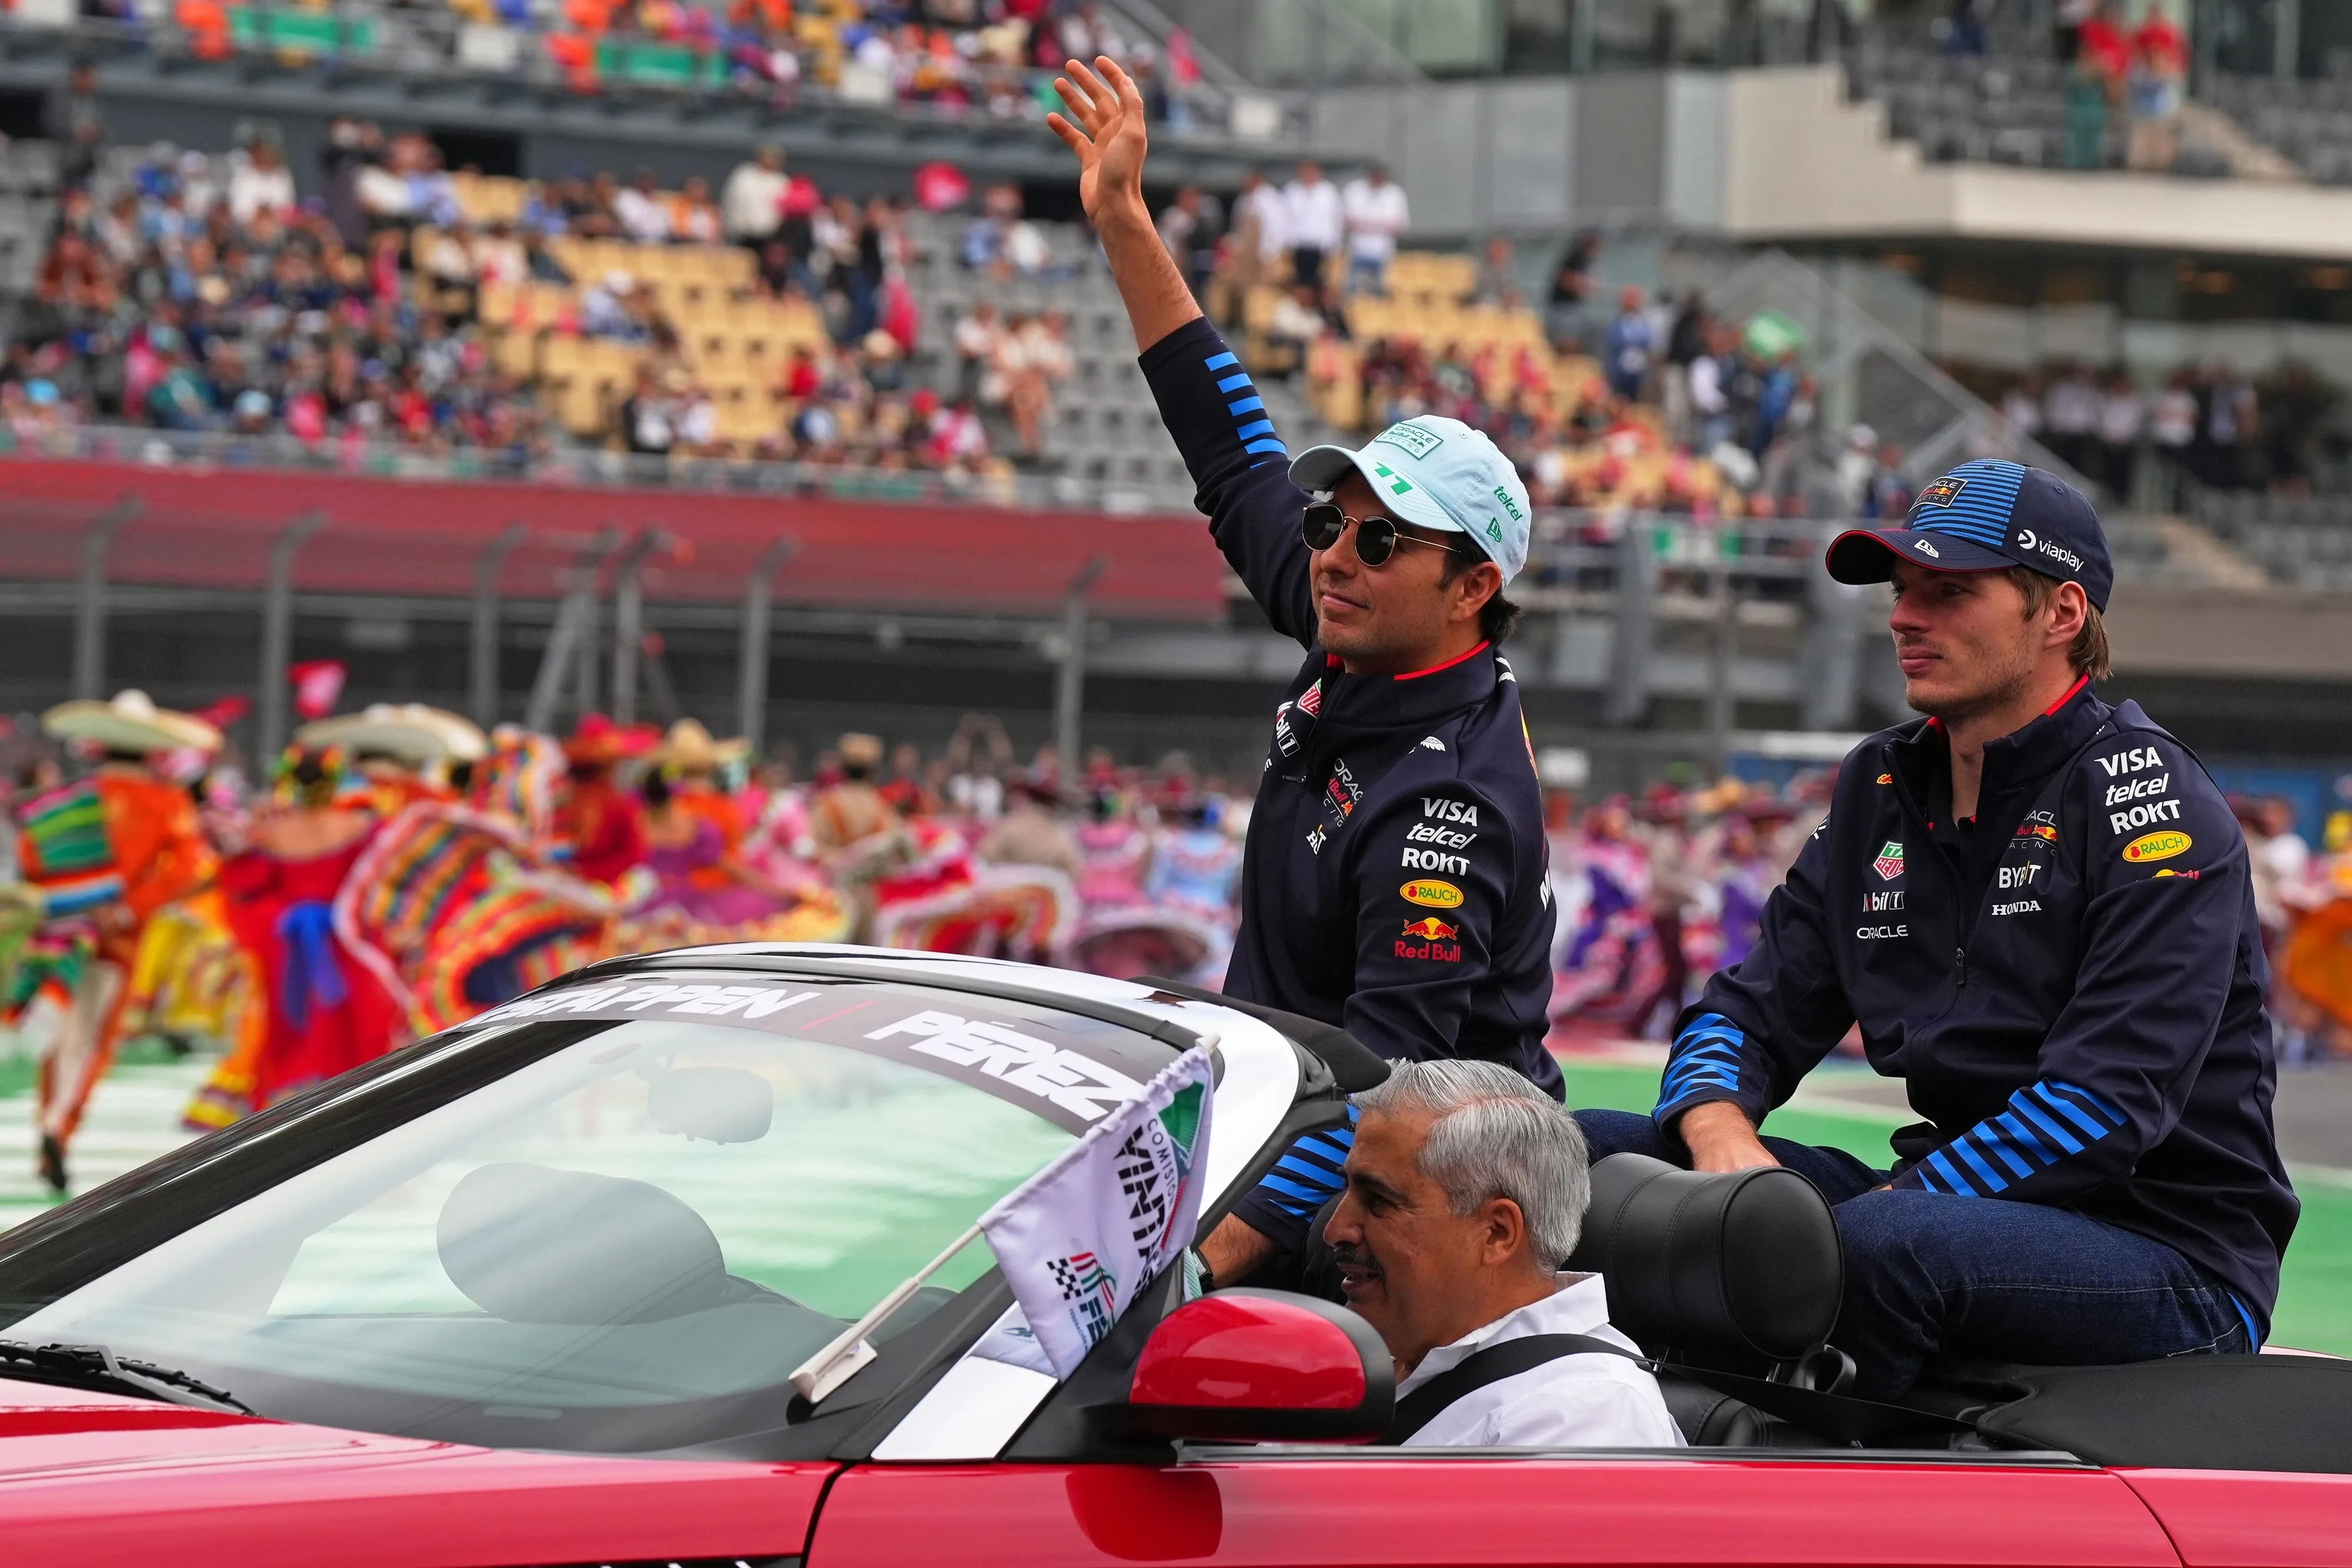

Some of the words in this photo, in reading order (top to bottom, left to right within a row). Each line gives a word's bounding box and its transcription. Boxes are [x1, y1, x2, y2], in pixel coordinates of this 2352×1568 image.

[1382, 436, 1421, 453] RACING
[1395, 426, 1434, 444] ORACLE
[1375, 462, 1413, 495] 11
[1928, 480, 1959, 489] ACLE
[1494, 486, 1523, 521] telcel
[2039, 540, 2084, 571] viaplay
[1281, 738, 1296, 750] 1
[2093, 747, 2164, 777] VISA
[1334, 758, 1364, 804] ORAC
[2105, 773, 2169, 806] telcel
[1323, 798, 1344, 828] CING
[1419, 797, 1478, 827] VISA
[2024, 809, 2057, 827] ACL
[2109, 799, 2180, 835] ROKT
[1406, 823, 1478, 850] telcel
[2140, 836, 2184, 855] RAUCH
[1889, 845, 1903, 857] TA
[2009, 841, 2057, 857] ACN
[1401, 847, 1471, 876] ROKT
[1876, 858, 1904, 878] HEUE
[1418, 886, 1457, 903] RAUCH
[1992, 900, 2042, 915] HONDA
[1856, 925, 1909, 940] ORACLE
[1395, 940, 1430, 959] Red
[1432, 943, 1461, 962] Bull
[454, 985, 822, 1028] STAPPEN
